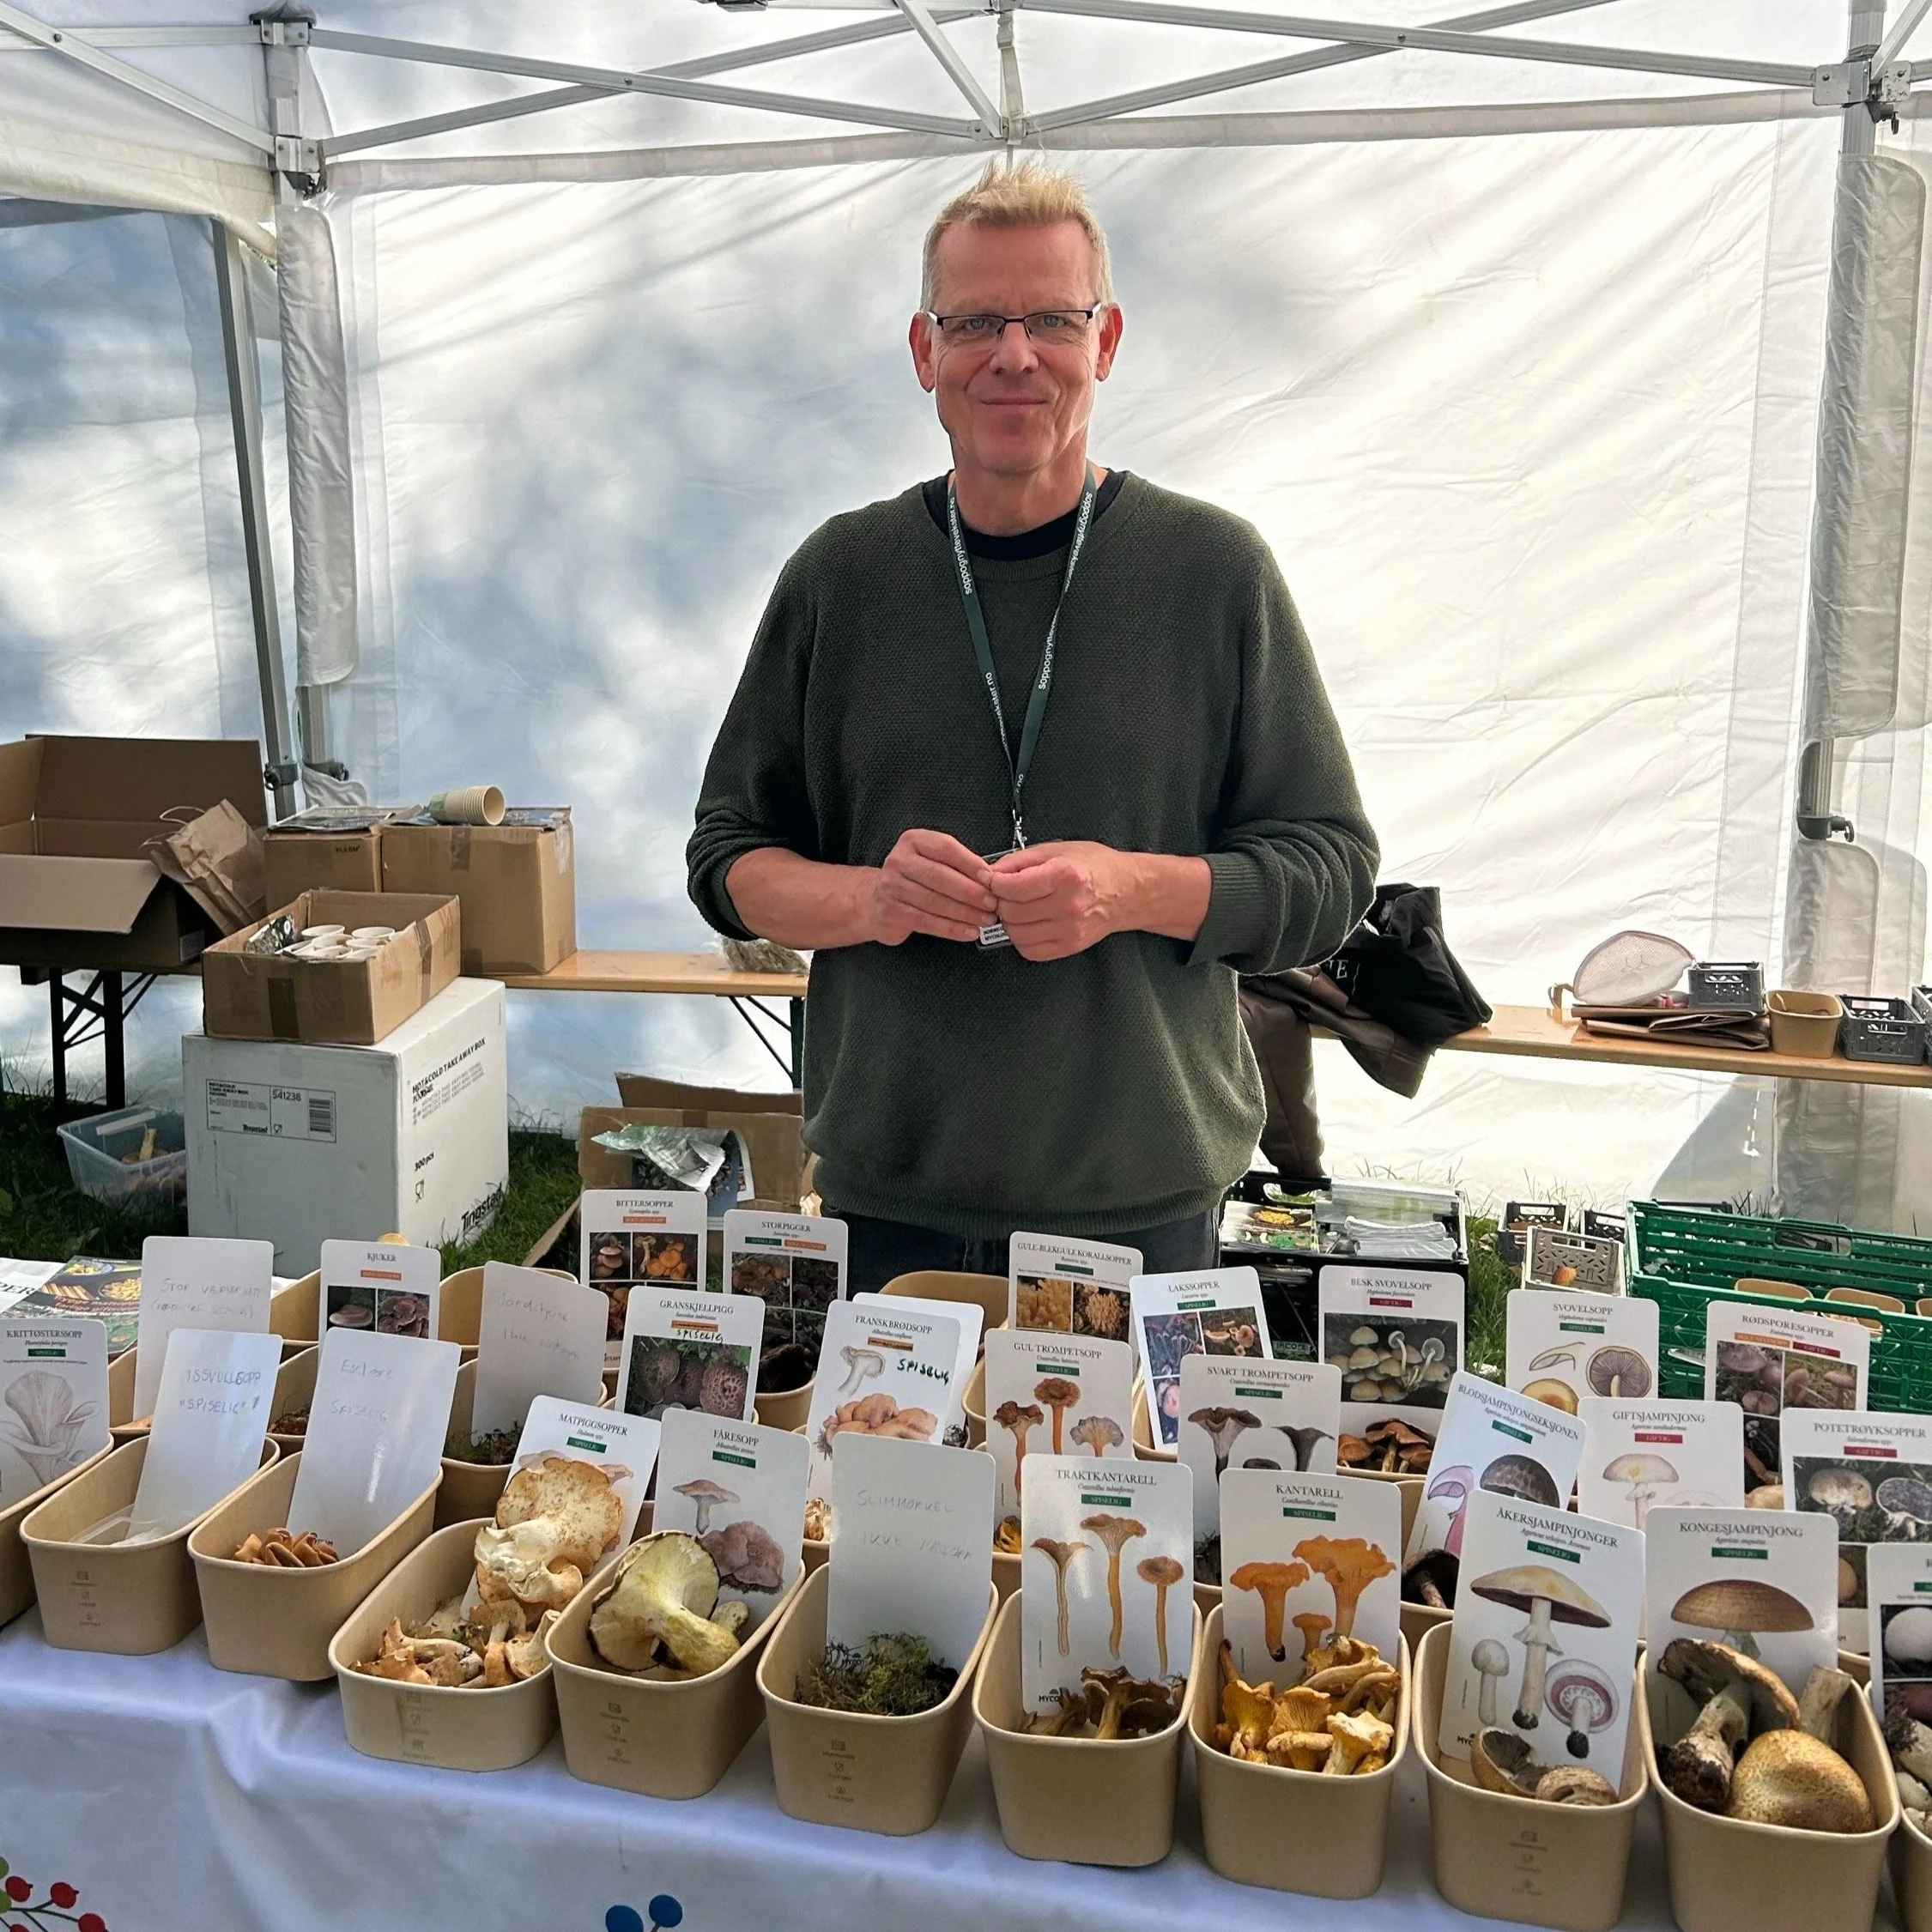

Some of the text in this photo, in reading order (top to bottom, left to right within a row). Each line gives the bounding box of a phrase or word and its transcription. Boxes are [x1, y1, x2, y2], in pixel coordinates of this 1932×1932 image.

[459, 1045, 474, 1062] AWAY
[272, 1091, 301, 1101] 541238
[616, 1199, 674, 1208] BITTERSOPPER
[761, 1221, 811, 1232] STORPIGGER
[366, 1252, 397, 1263] KJUKER
[1078, 1251, 1132, 1266] KORALLSOPPER
[1168, 1281, 1220, 1293] LAKSSOPPER
[1351, 1278, 1432, 1291] BESK SVOVELSOPP
[660, 1299, 734, 1315] GRANSKJELLPIGG
[1553, 1302, 1614, 1316] SVOVELSOPP
[855, 1314, 932, 1335] FRANSKBRØDSOPP
[1742, 1314, 1834, 1338] RØDSPORESOPPER
[7, 1329, 83, 1339] KRITTØSTERSSOPP
[1014, 1341, 1102, 1360] GUL TROMPETSOPP
[1208, 1366, 1314, 1383] SVART TROMPETSOPP
[1458, 1384, 1579, 1441] BLODSJAMPINJONGSEKSJONEN
[1613, 1410, 1705, 1424] GIFTSJAMPINJONG
[559, 1413, 628, 1436] MATPIGGSOPPER
[1814, 1422, 1926, 1438] POTETRØYKSOPPER
[713, 1428, 760, 1447] FÅRESOPP
[1057, 1469, 1157, 1486] TRAKTKANTARELL
[1276, 1485, 1343, 1499] KANTARELL
[1497, 1507, 1619, 1548] ÅKERSJAMPINJONGER
[1680, 1523, 1803, 1538] KONGESJAMPINJONG
